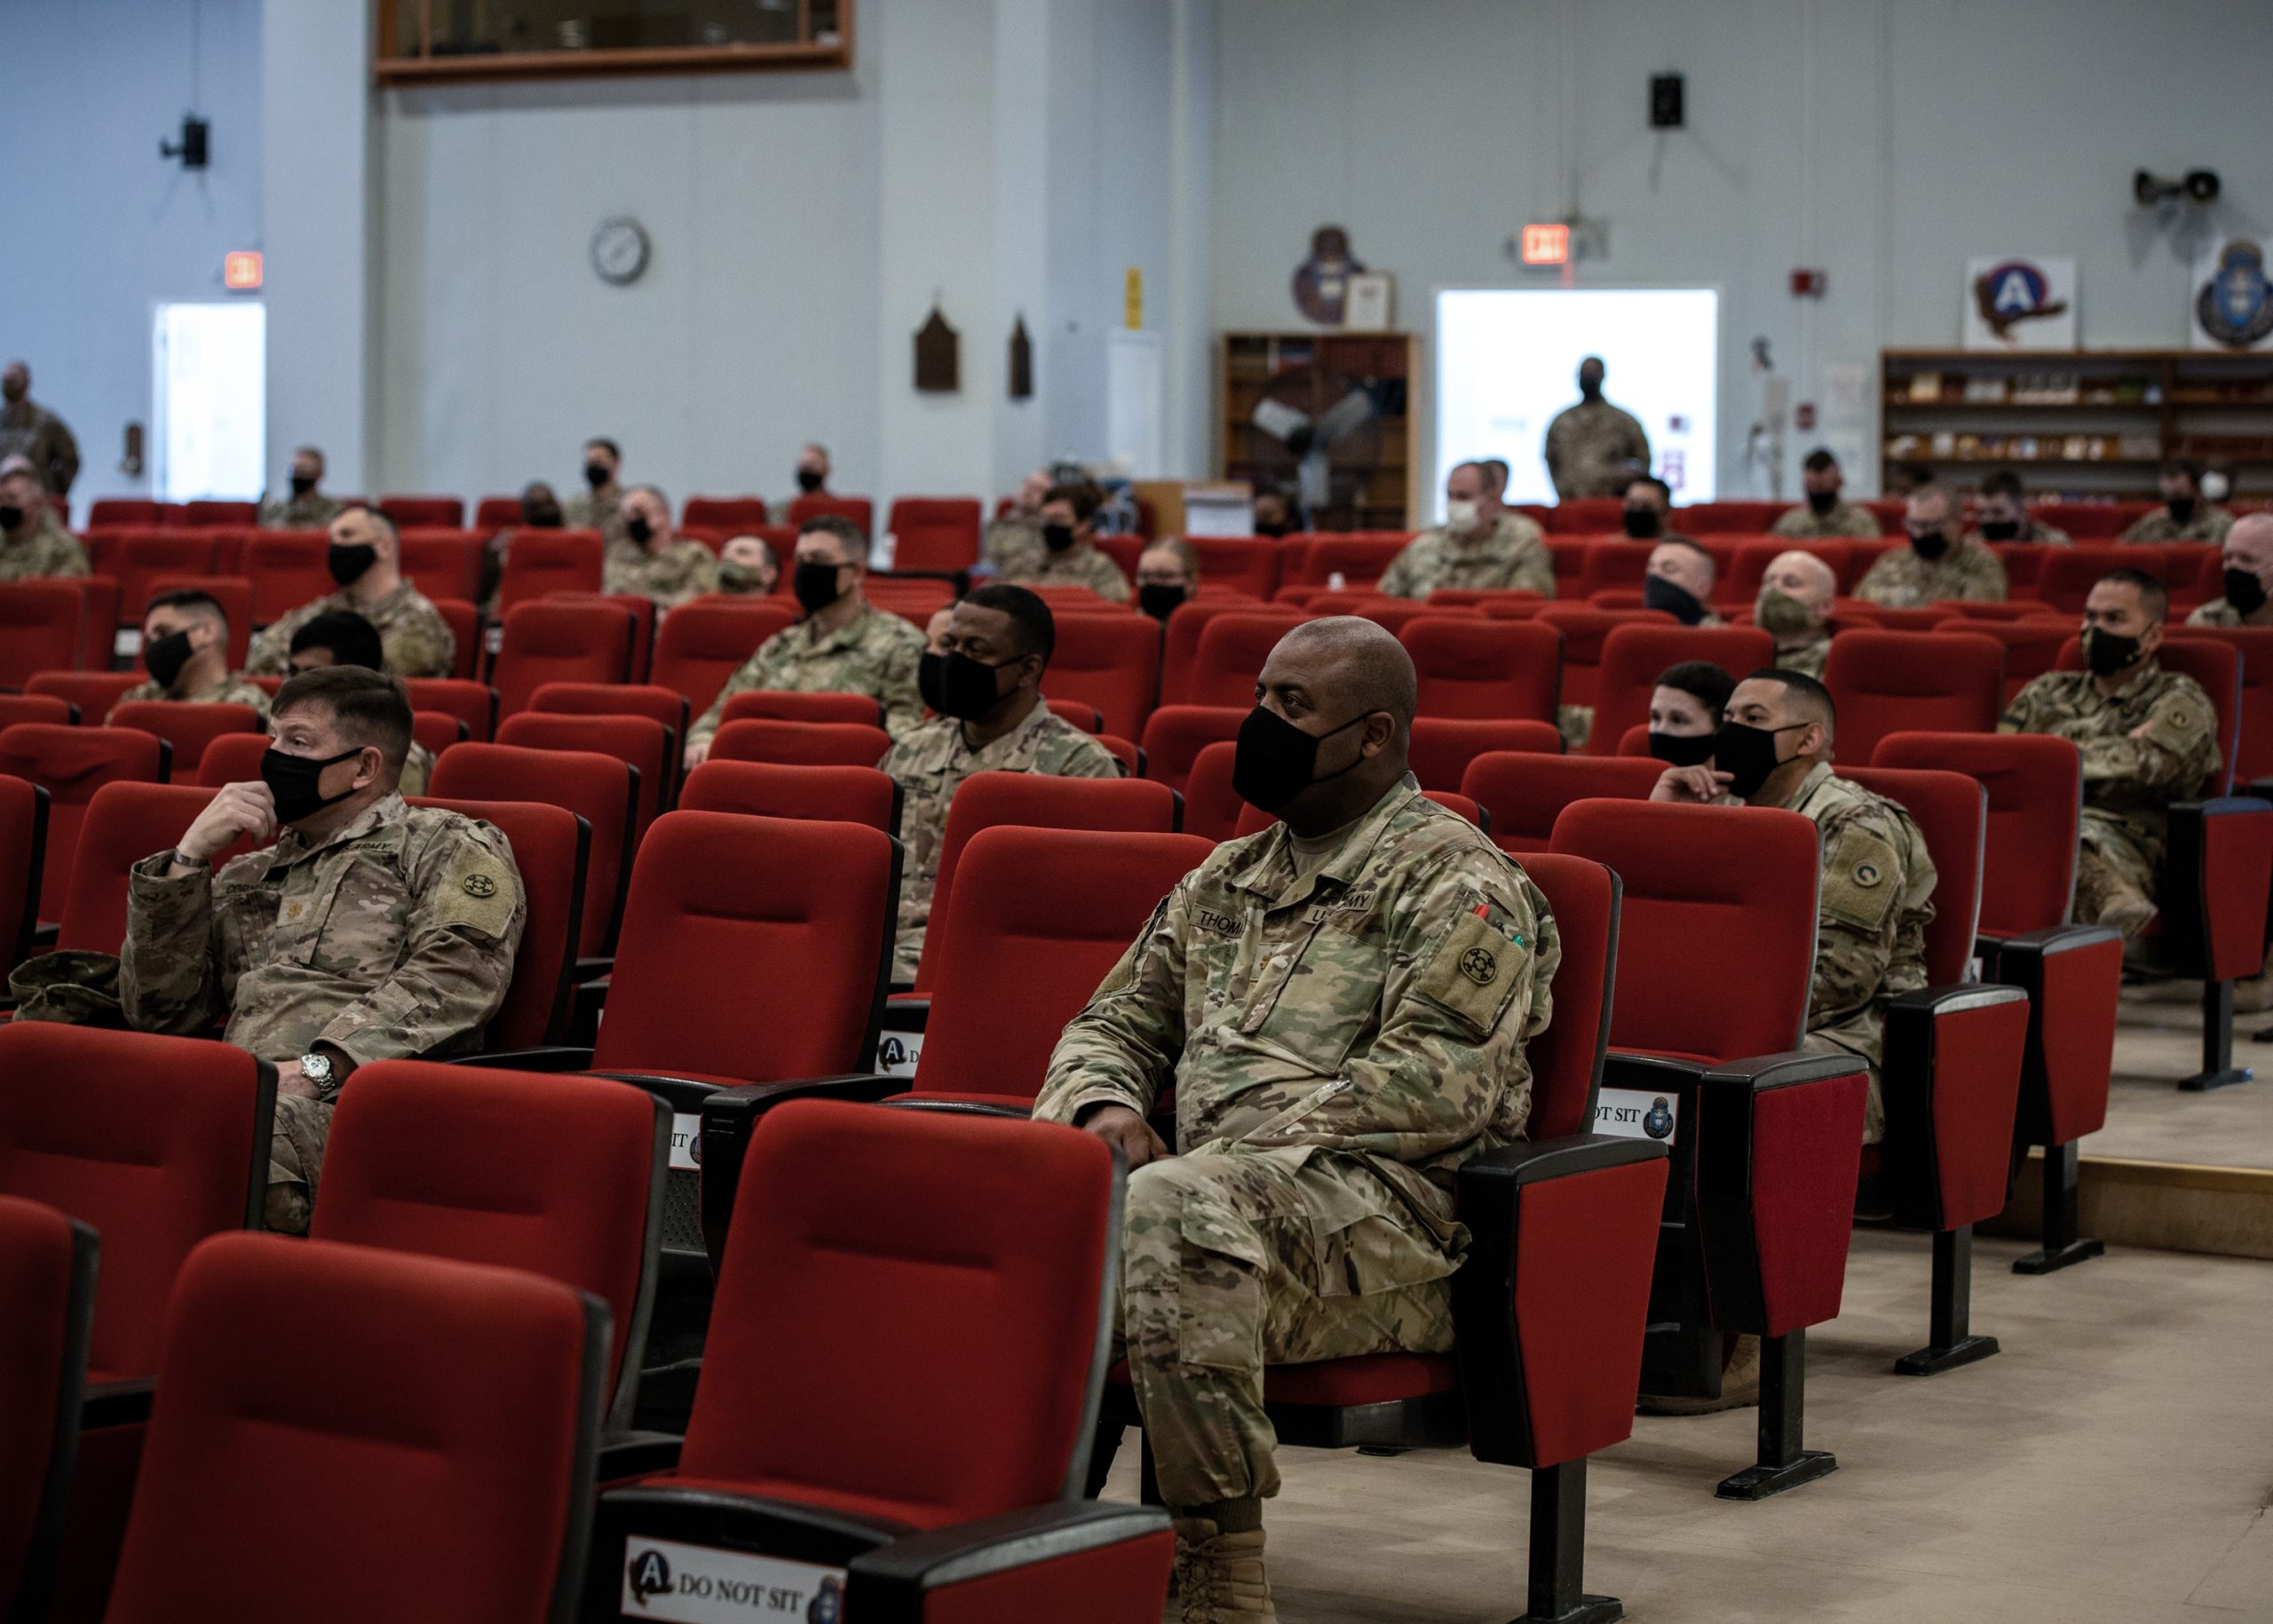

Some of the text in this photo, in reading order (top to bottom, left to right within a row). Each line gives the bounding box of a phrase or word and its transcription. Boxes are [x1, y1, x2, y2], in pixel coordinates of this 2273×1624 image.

[1994, 269, 2037, 313] A
[1200, 910, 1243, 934] THOM
[885, 1040, 899, 1060] A
[909, 1050, 920, 1063] D
[1614, 1107, 1641, 1122] SIT
[671, 1133, 689, 1148] IT
[639, 1554, 662, 1588] A
[679, 1573, 804, 1613] DO NOT SIT
